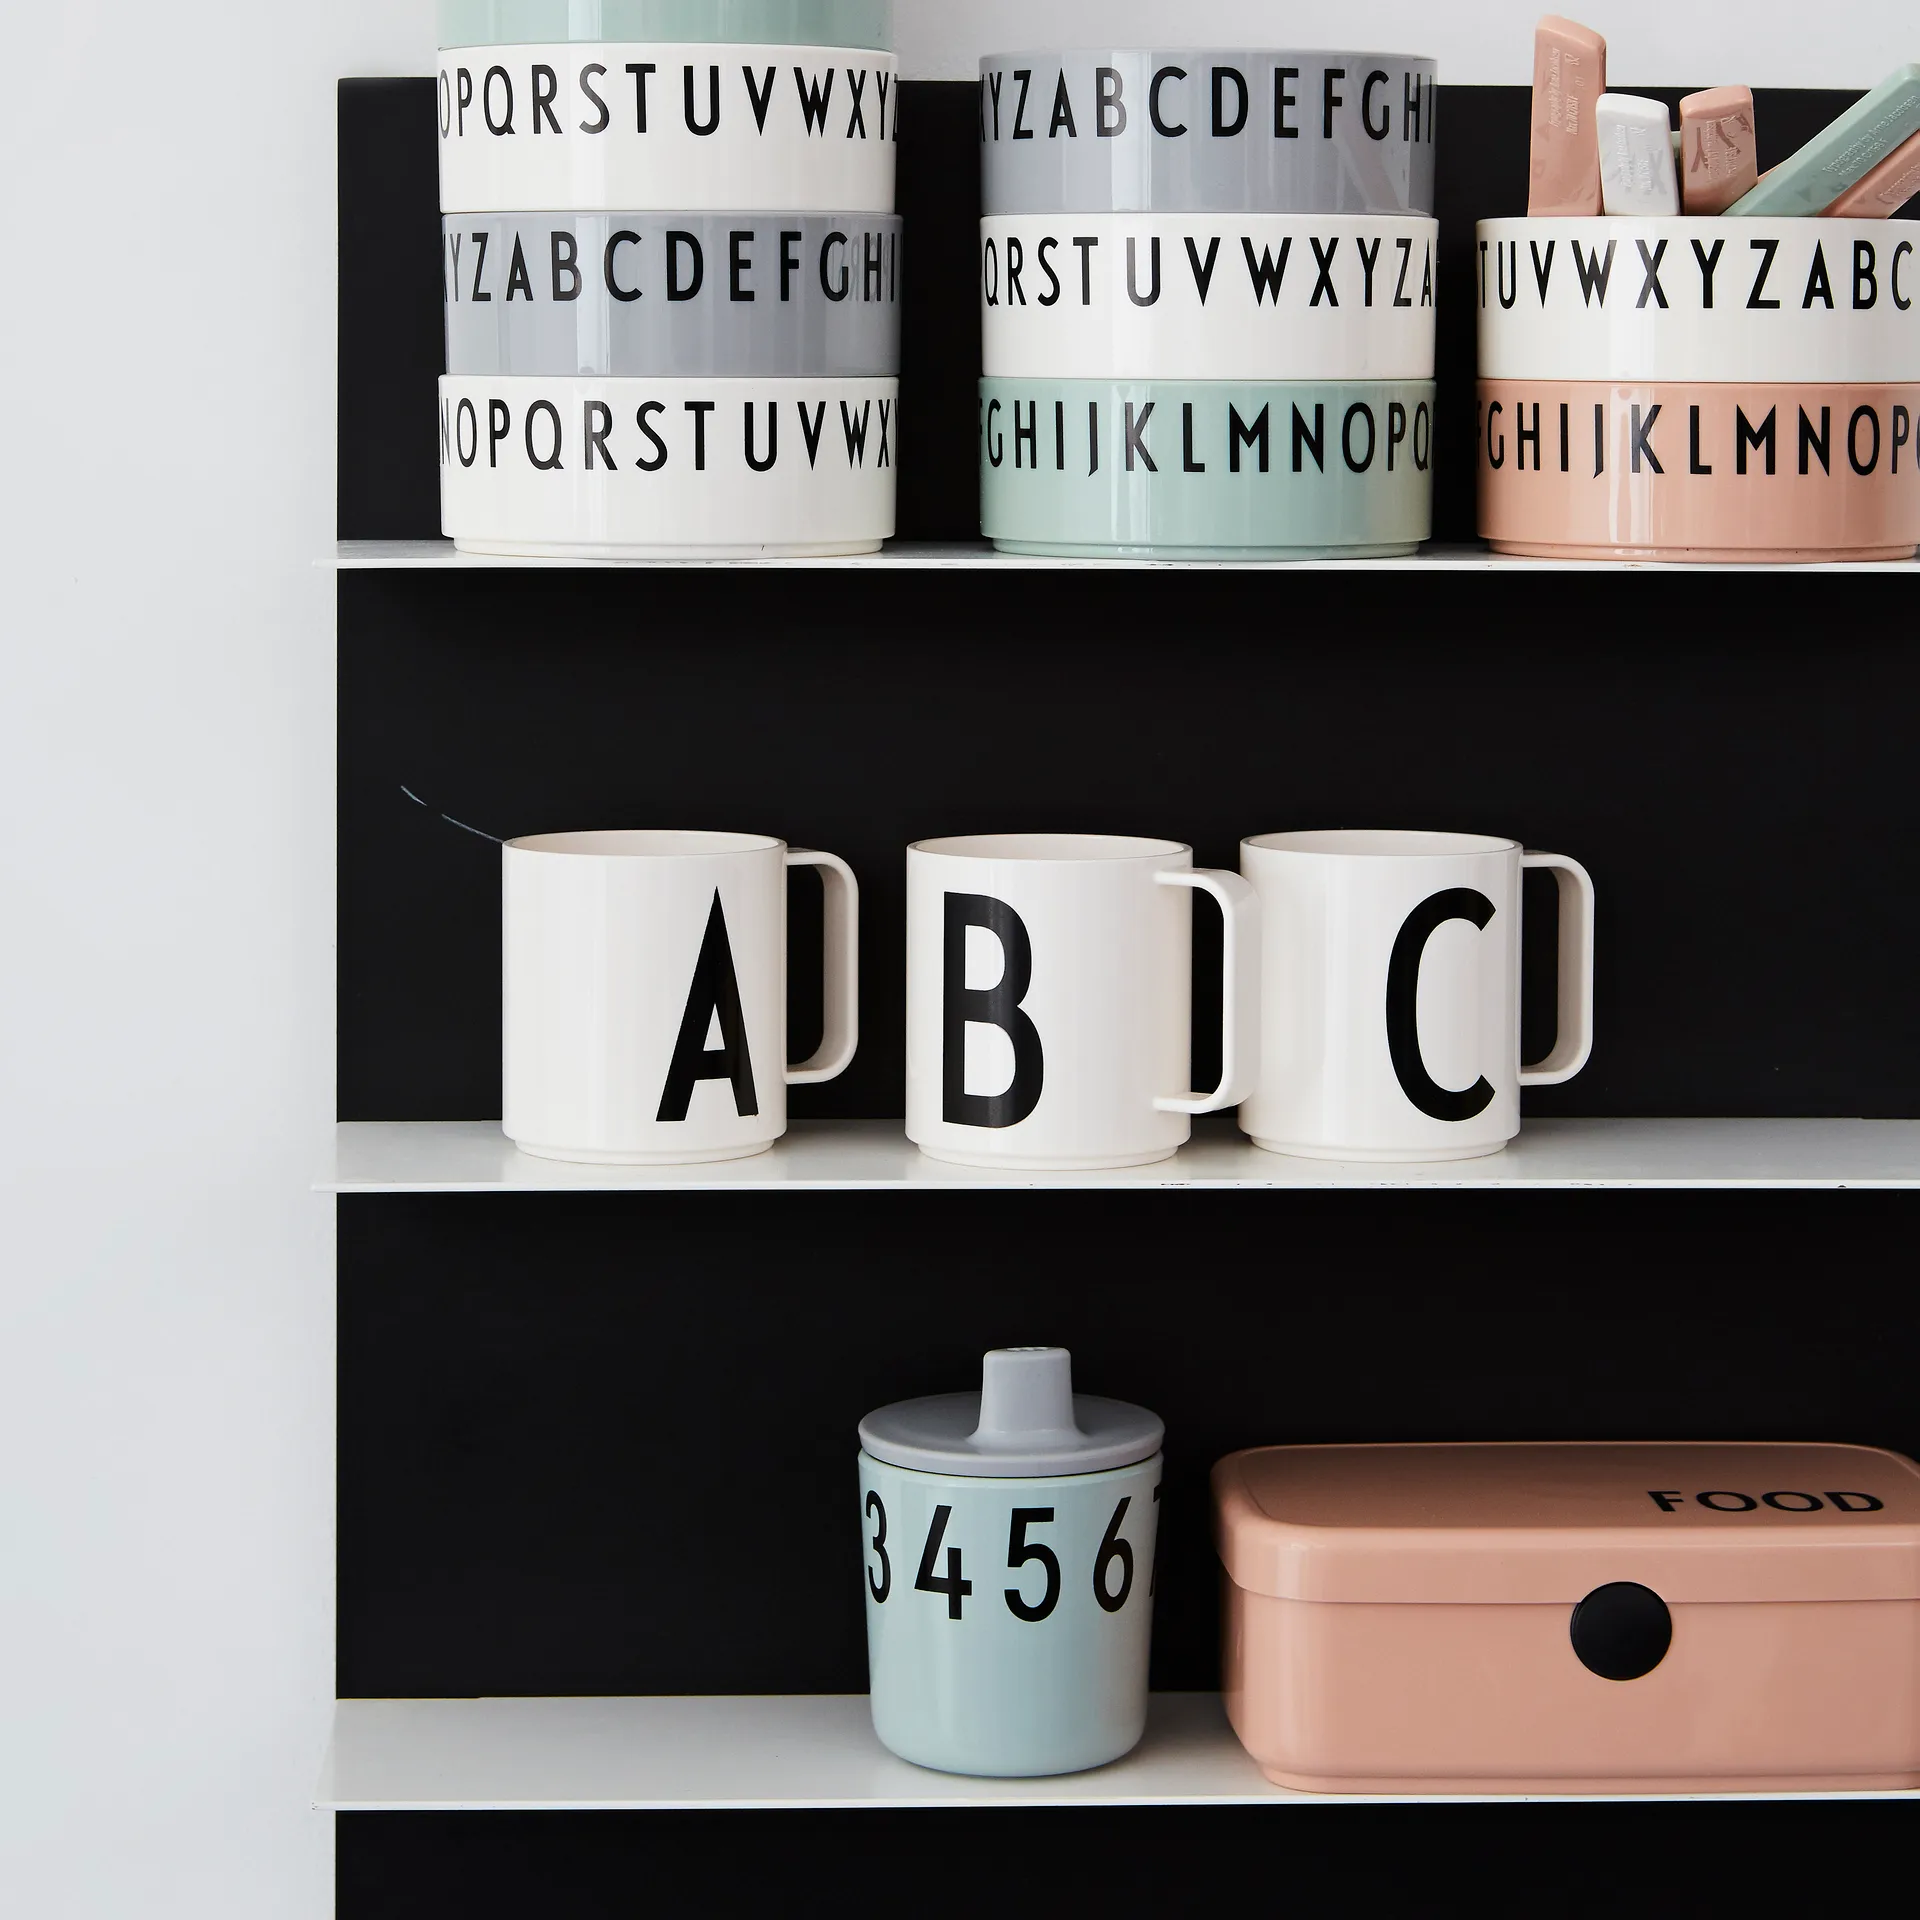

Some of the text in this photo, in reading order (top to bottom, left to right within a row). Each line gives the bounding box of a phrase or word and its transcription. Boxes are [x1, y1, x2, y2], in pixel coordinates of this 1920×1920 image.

[656, 886, 759, 1123] A
[943, 891, 1044, 1128] B
[1386, 887, 1496, 1122] C
[1648, 1490, 1884, 1512] FOOD
